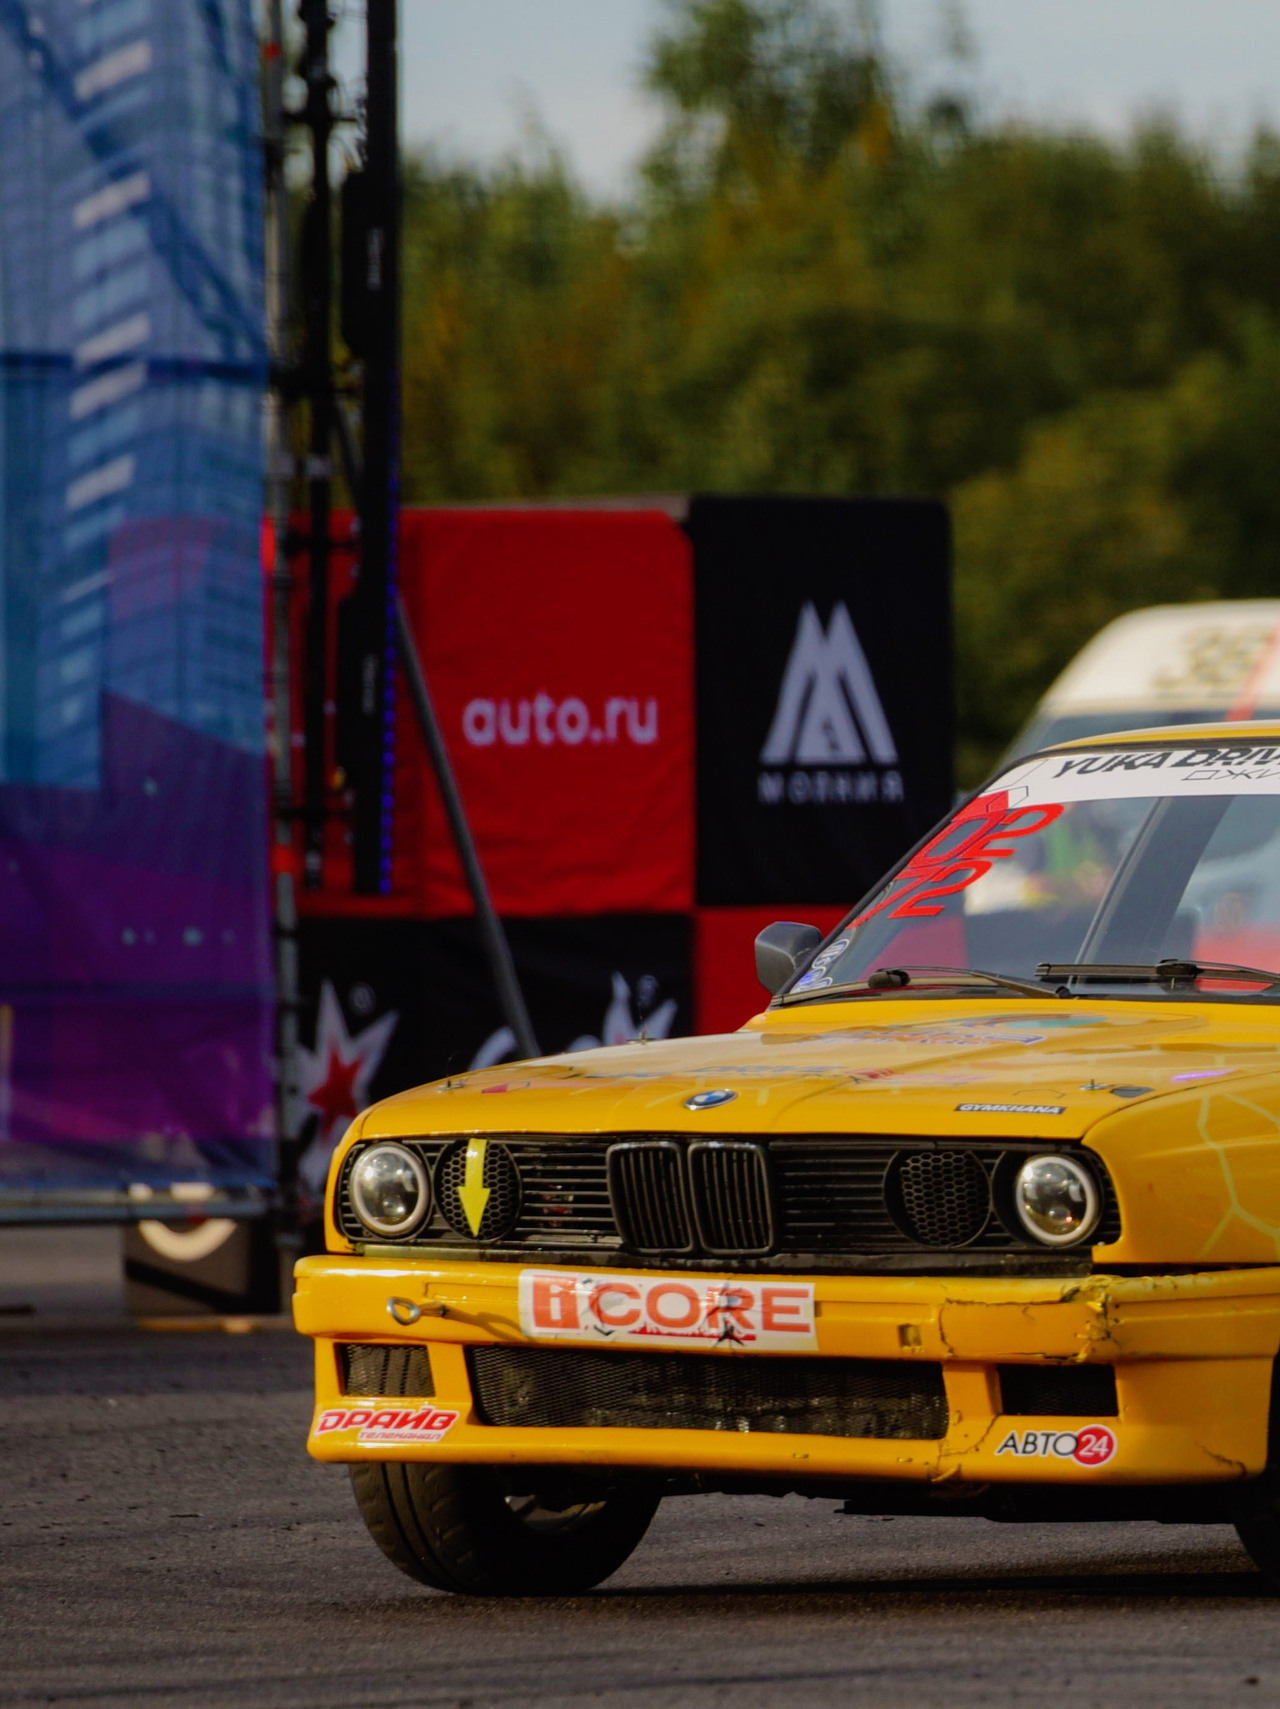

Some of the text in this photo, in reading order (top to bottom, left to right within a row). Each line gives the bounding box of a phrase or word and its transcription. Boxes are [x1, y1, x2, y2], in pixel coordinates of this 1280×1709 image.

[463, 691, 657, 745] auto.ru
[1052, 753, 1172, 779] YUKA
[959, 1104, 1062, 1114] GYMKHANA
[318, 1407, 457, 1432] ДРАЙВ
